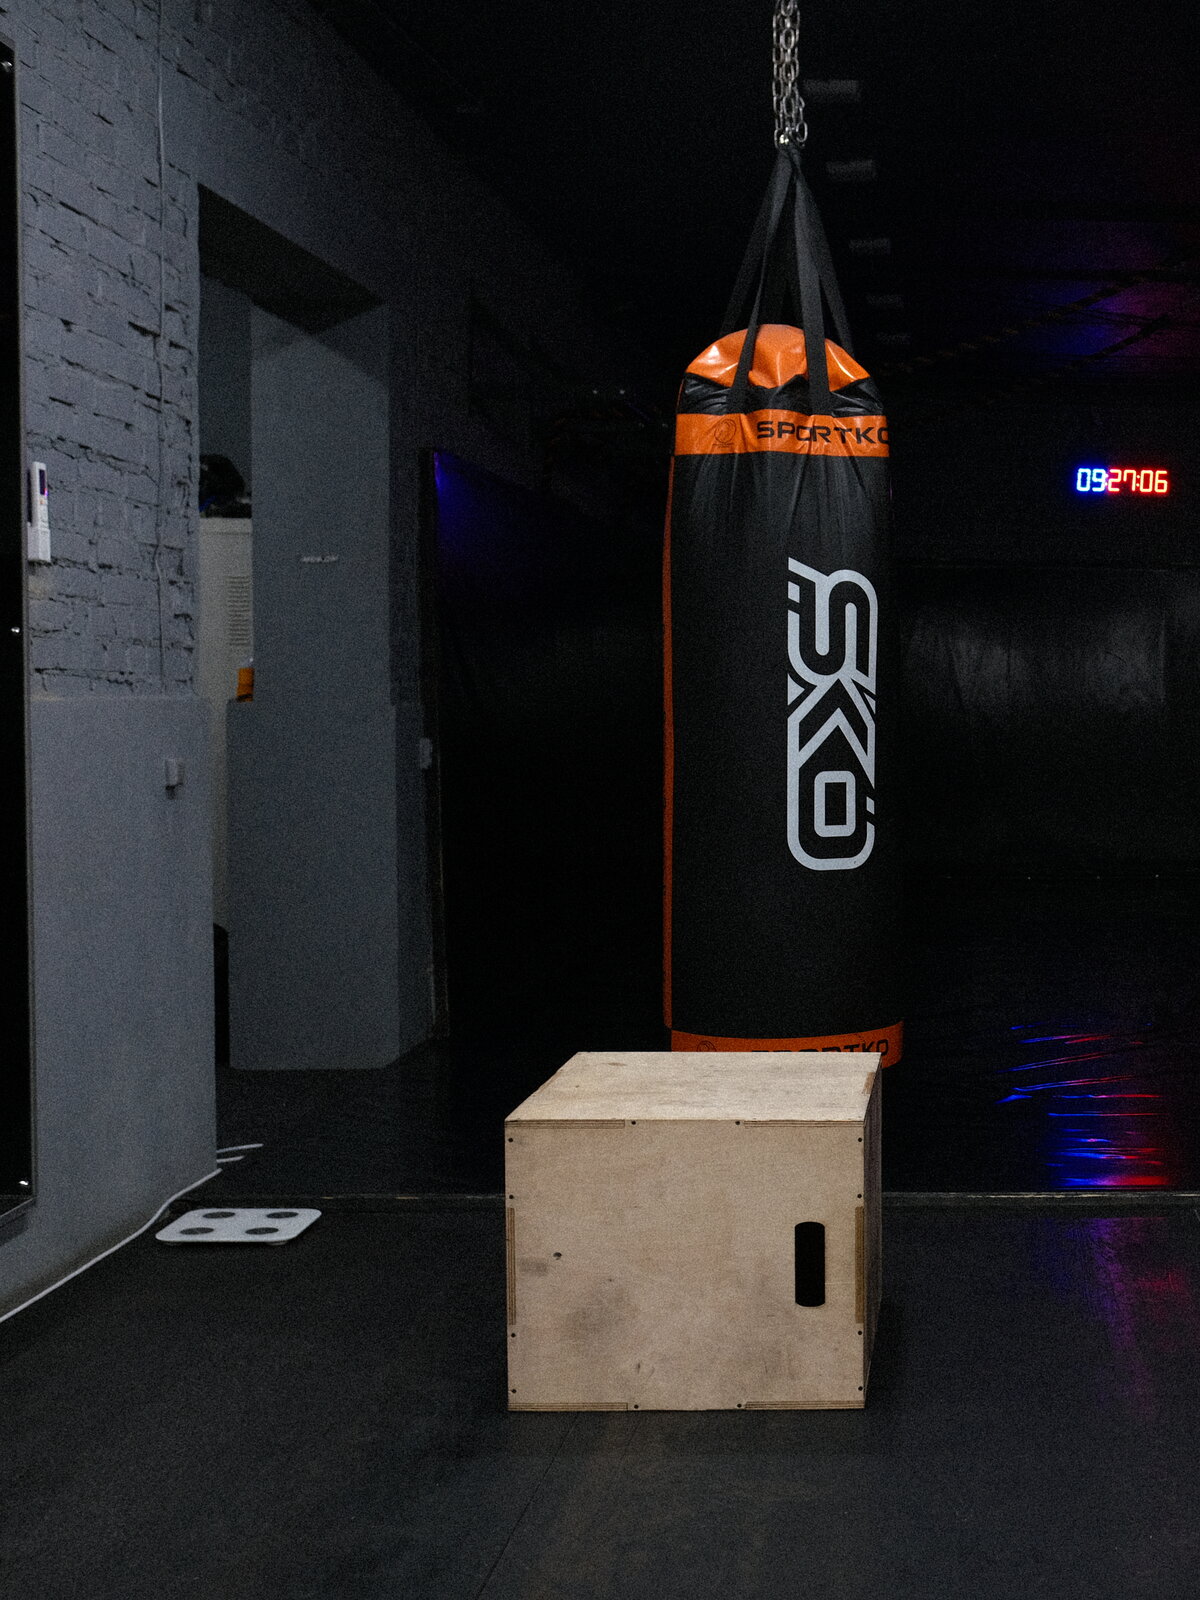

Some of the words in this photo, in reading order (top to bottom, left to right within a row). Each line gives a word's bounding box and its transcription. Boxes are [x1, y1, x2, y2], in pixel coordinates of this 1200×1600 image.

[756, 420, 889, 445] SPORTKO
[1076, 467, 1168, 493] 09:27:06
[787, 556, 878, 871] SKO
